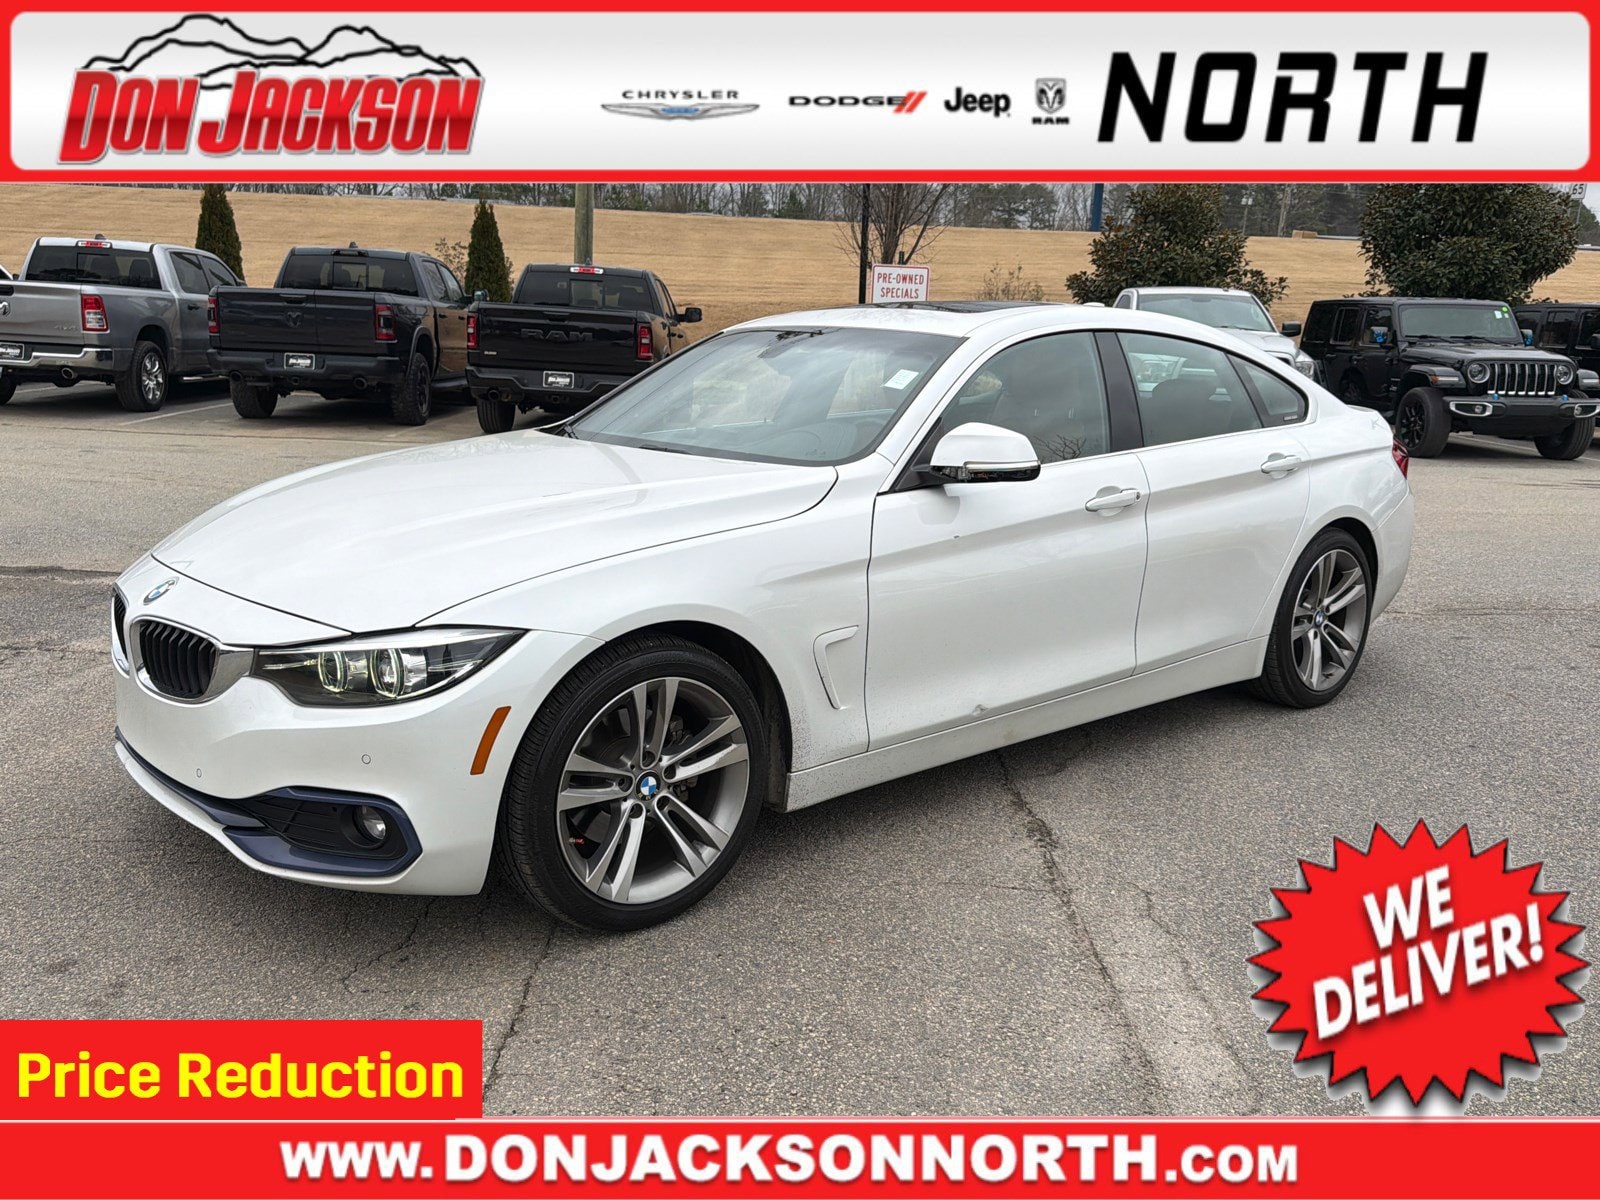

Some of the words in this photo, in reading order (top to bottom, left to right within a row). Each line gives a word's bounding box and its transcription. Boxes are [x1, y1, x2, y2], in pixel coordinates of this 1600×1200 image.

[1572, 183, 1585, 195] 65
[877, 272, 925, 285] PRE-OWNED
[880, 287, 919, 299] SPECIALS
[520, 328, 593, 341] RAM
